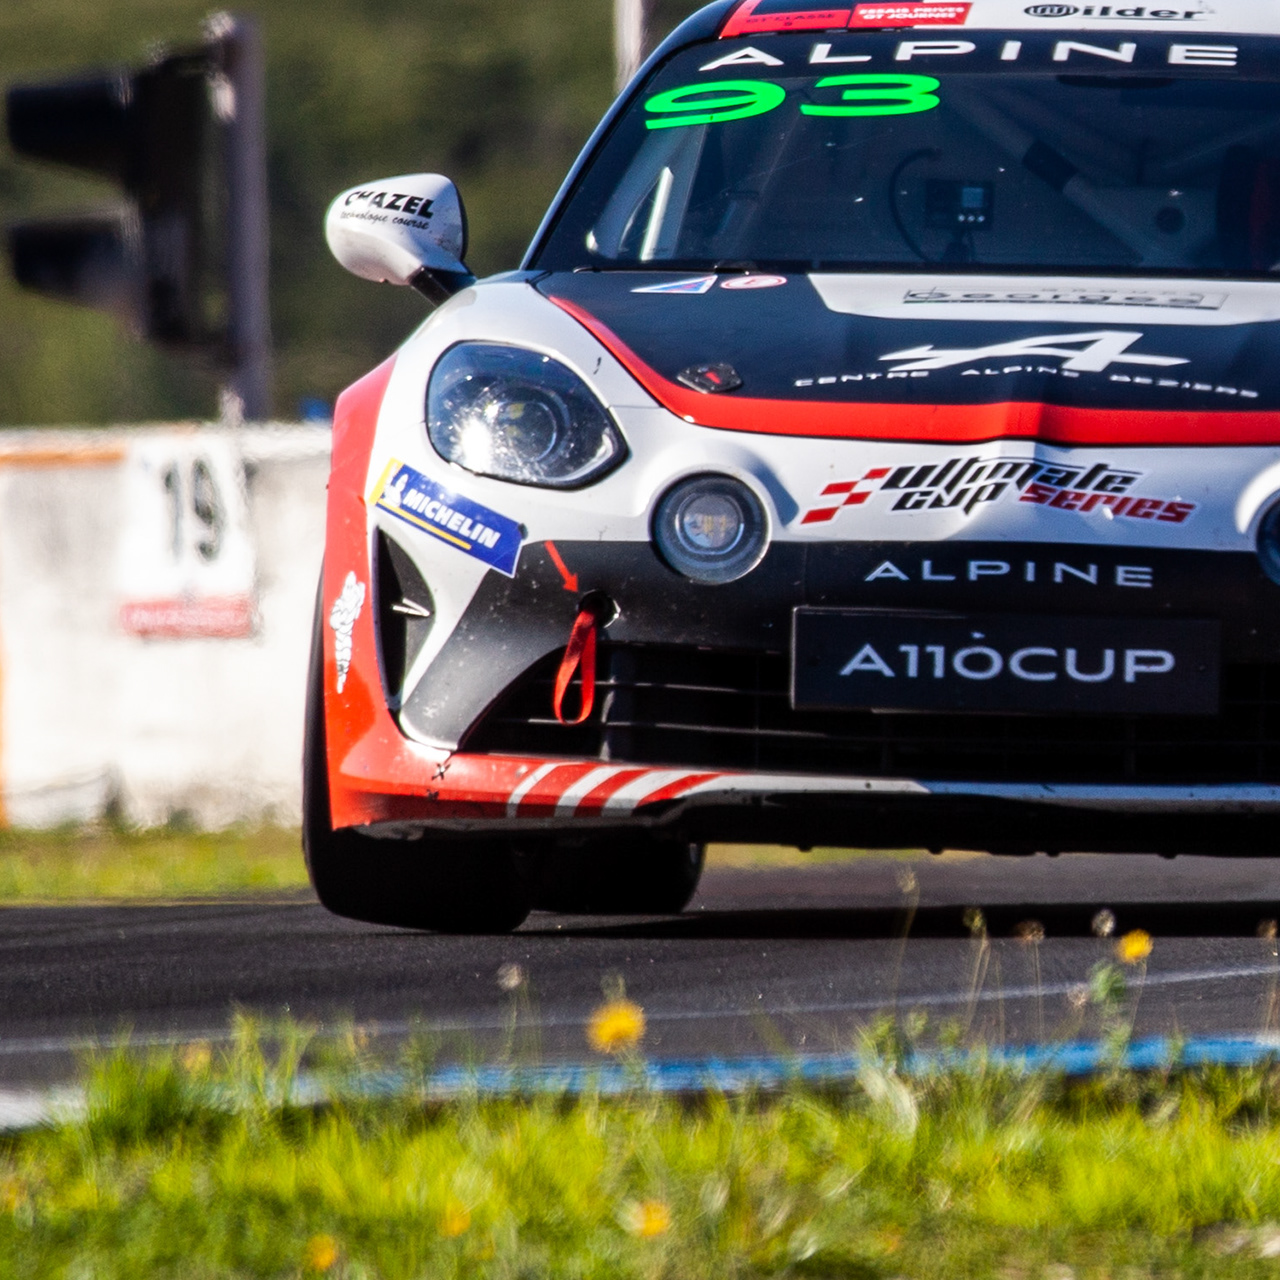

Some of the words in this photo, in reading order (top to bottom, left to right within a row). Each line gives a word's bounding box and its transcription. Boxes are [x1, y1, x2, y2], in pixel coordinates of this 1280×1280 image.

[699, 40, 1239, 71] ALPINE
[644, 73, 940, 129] 93
[345, 190, 434, 219] CHAZEL
[392, 217, 429, 230] course
[960, 365, 1080, 378] ALPINE
[161, 457, 227, 562] 19
[891, 482, 1010, 516] cup
[1019, 483, 1196, 523] series
[403, 488, 500, 549] MICHELIN
[865, 560, 1153, 588] ALPINE
